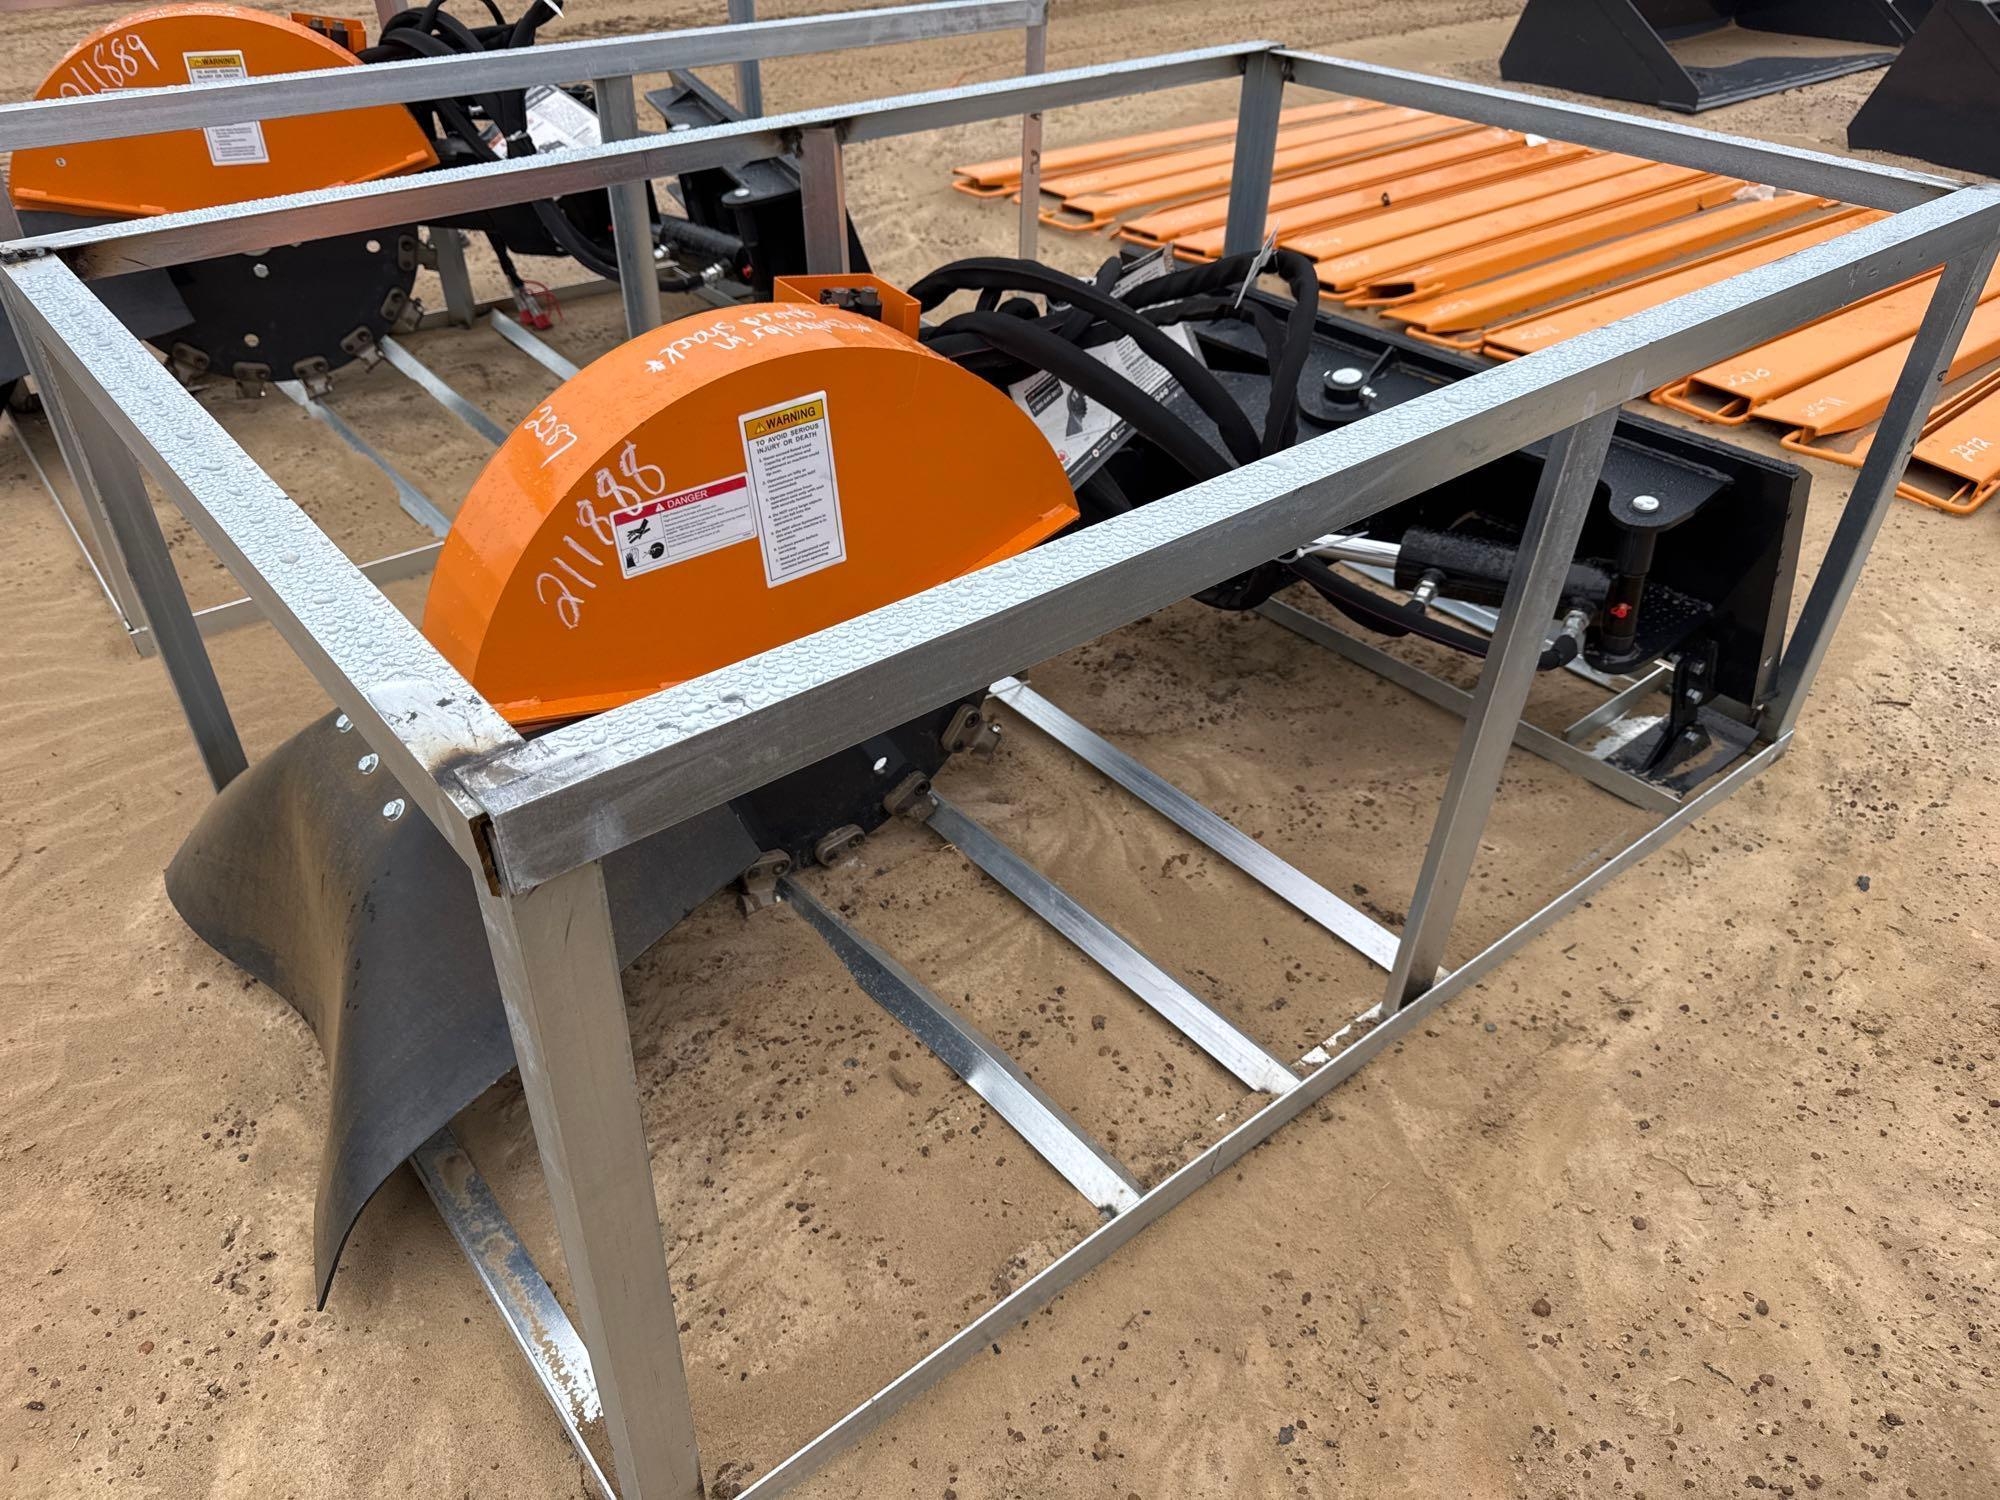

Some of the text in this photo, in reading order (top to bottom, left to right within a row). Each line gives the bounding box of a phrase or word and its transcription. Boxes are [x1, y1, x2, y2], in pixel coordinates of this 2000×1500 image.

[766, 406, 815, 429] WARNING
[524, 405, 578, 468] 2287
[757, 431, 816, 454] INJURY OR DEATH
[767, 432, 787, 443] AVOID
[790, 423, 818, 436] SERIOUS
[666, 490, 709, 509] DANGER
[536, 440, 666, 629] 211888
